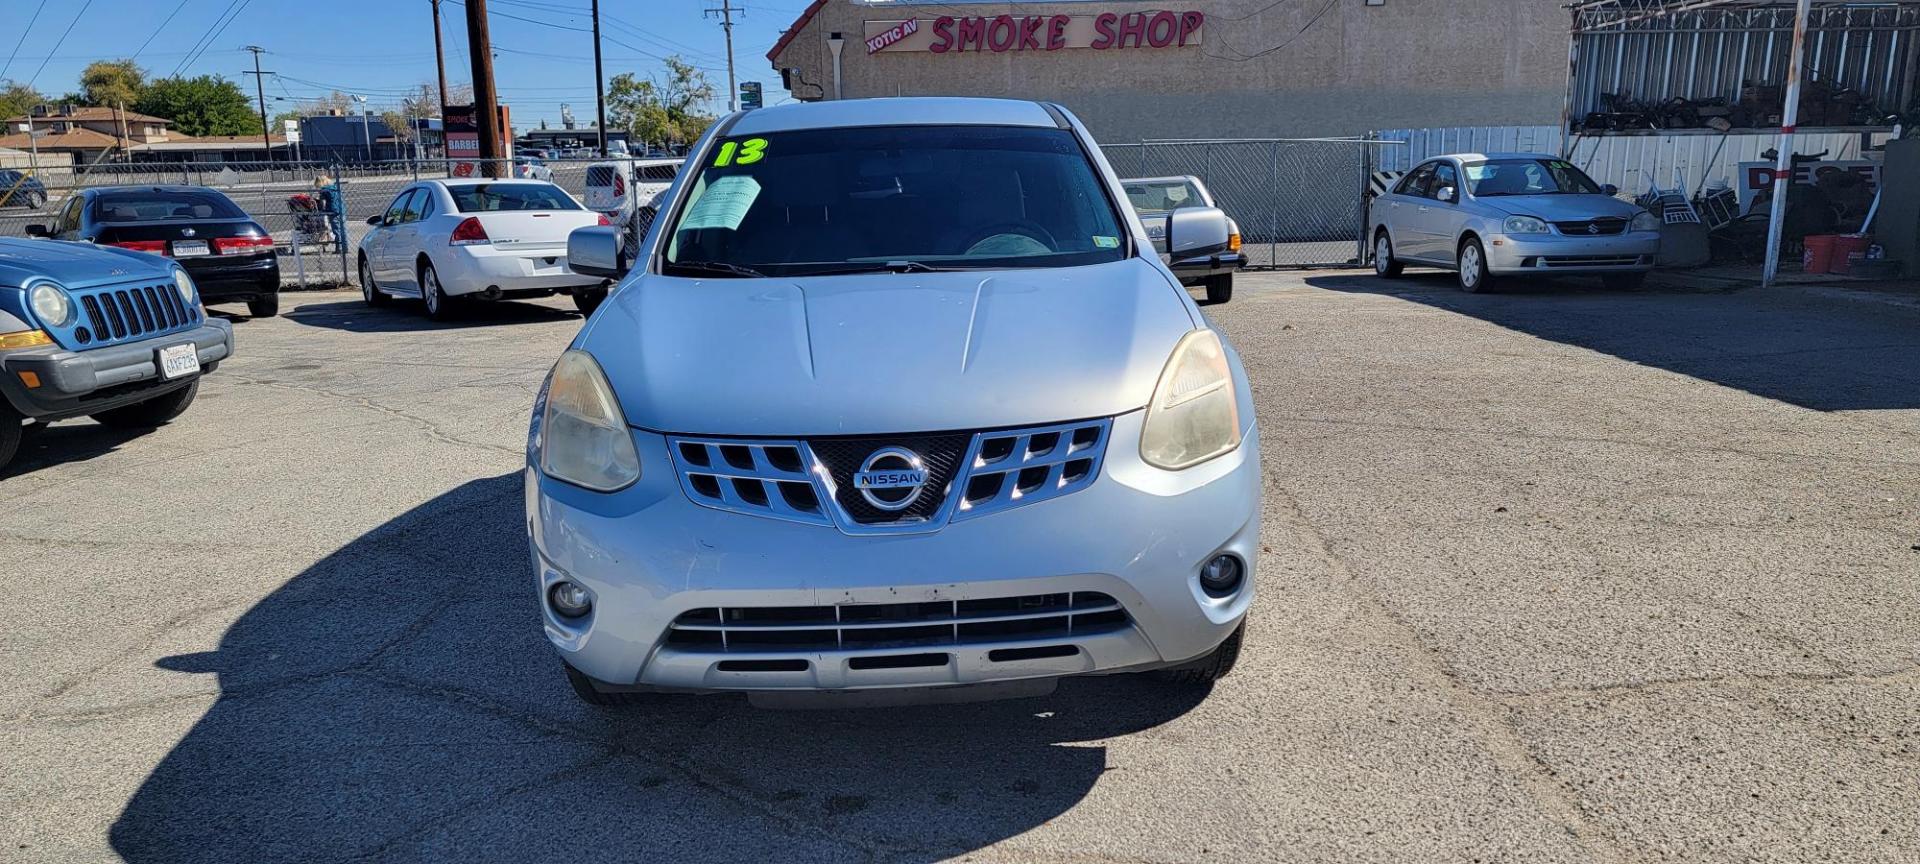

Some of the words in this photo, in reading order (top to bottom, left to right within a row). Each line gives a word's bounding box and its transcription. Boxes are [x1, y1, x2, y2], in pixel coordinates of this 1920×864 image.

[866, 27, 902, 53] XOTIC
[902, 19, 918, 36] AV
[929, 14, 1071, 53] SMOKE
[1091, 10, 1203, 50] SHOP
[446, 115, 469, 124] SMOKE
[714, 138, 768, 167] 13
[861, 473, 921, 485] NISSAN
